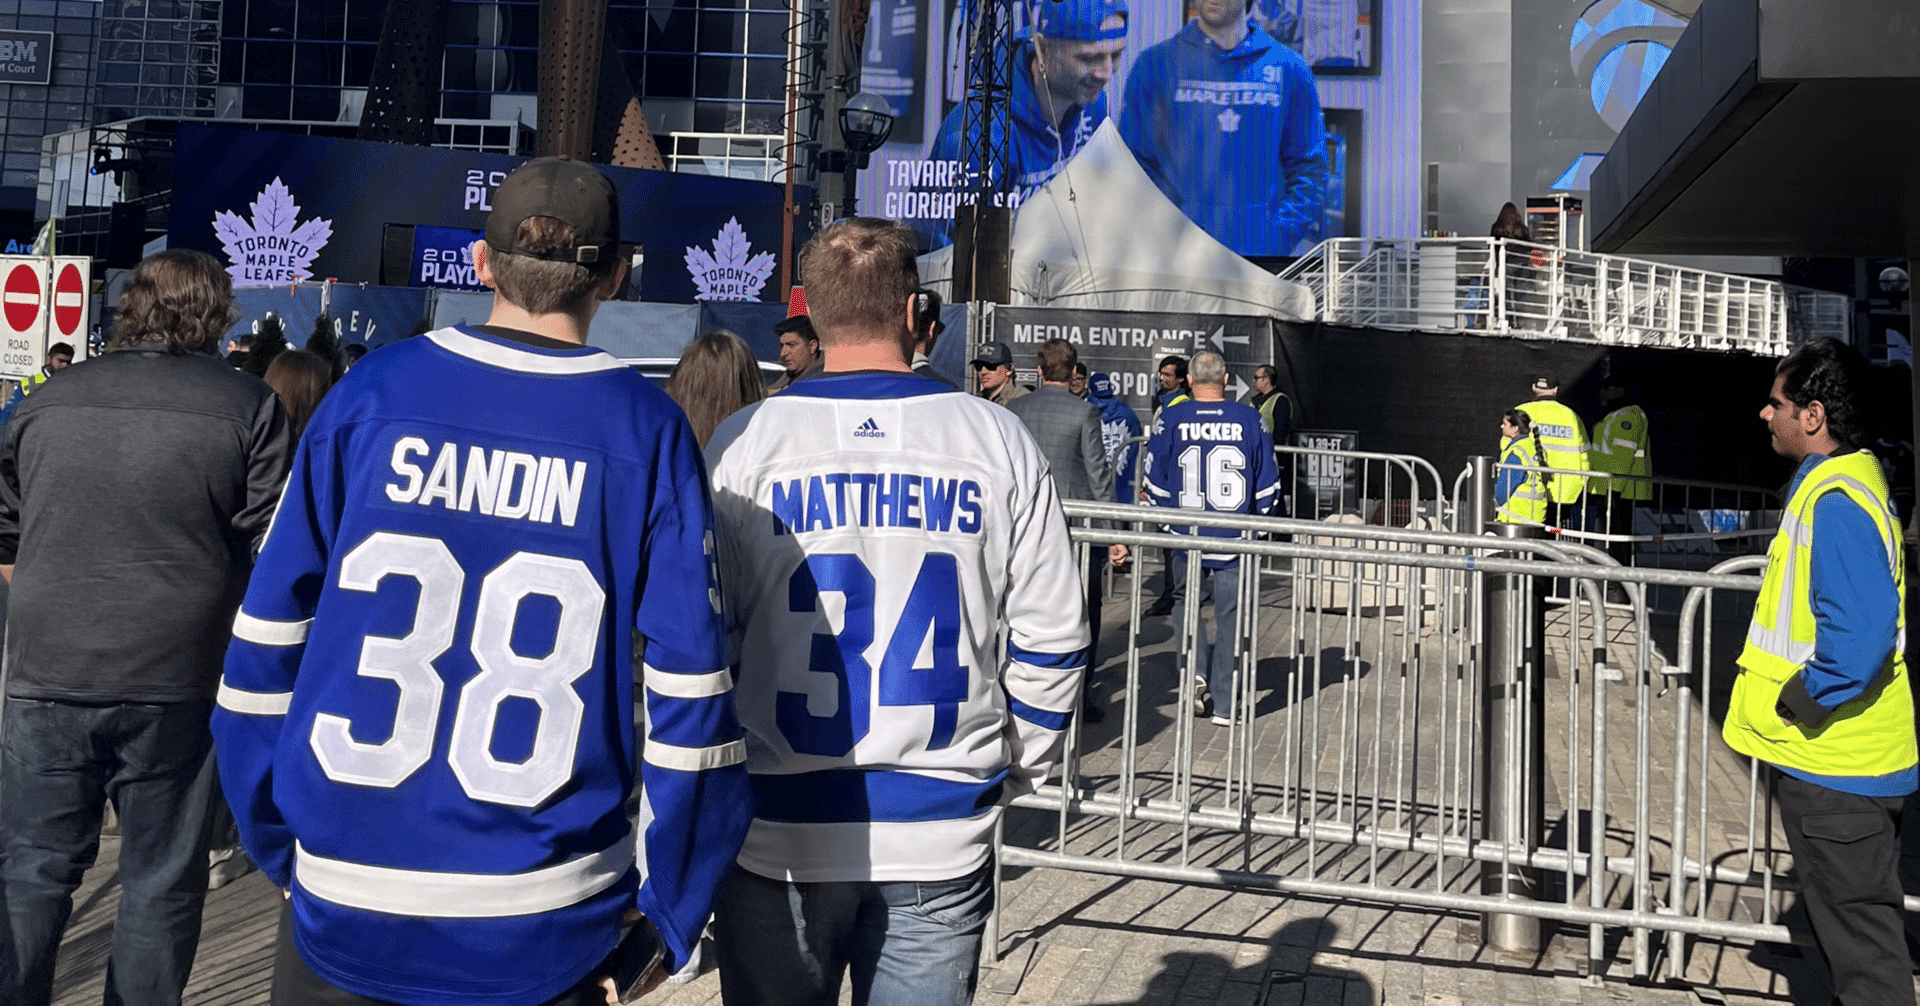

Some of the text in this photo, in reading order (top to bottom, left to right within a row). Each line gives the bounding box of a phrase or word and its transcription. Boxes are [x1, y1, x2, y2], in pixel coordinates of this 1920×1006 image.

[7, 63, 36, 73] Court
[1262, 65, 1281, 82] 91
[1175, 88, 1230, 106] MAPLE
[234, 235, 309, 258] TORONTO
[246, 253, 296, 268] MAPLE
[244, 268, 295, 282] LEAFS
[421, 262, 486, 286] PLAYO
[701, 267, 758, 287] TORONTO
[710, 283, 748, 296] MAPLE
[1013, 323, 1084, 346] MEDIA
[8, 338, 30, 351] ROAD
[3, 353, 33, 366] CLOSED
[853, 428, 886, 438] adidas
[1178, 422, 1244, 441] TUCKER
[1307, 452, 1342, 478] BIG
[385, 436, 587, 527] SANDIN
[1177, 444, 1246, 511] 16
[771, 472, 983, 536] MATTHEWS
[774, 551, 970, 758] 34
[309, 531, 607, 808] 38
